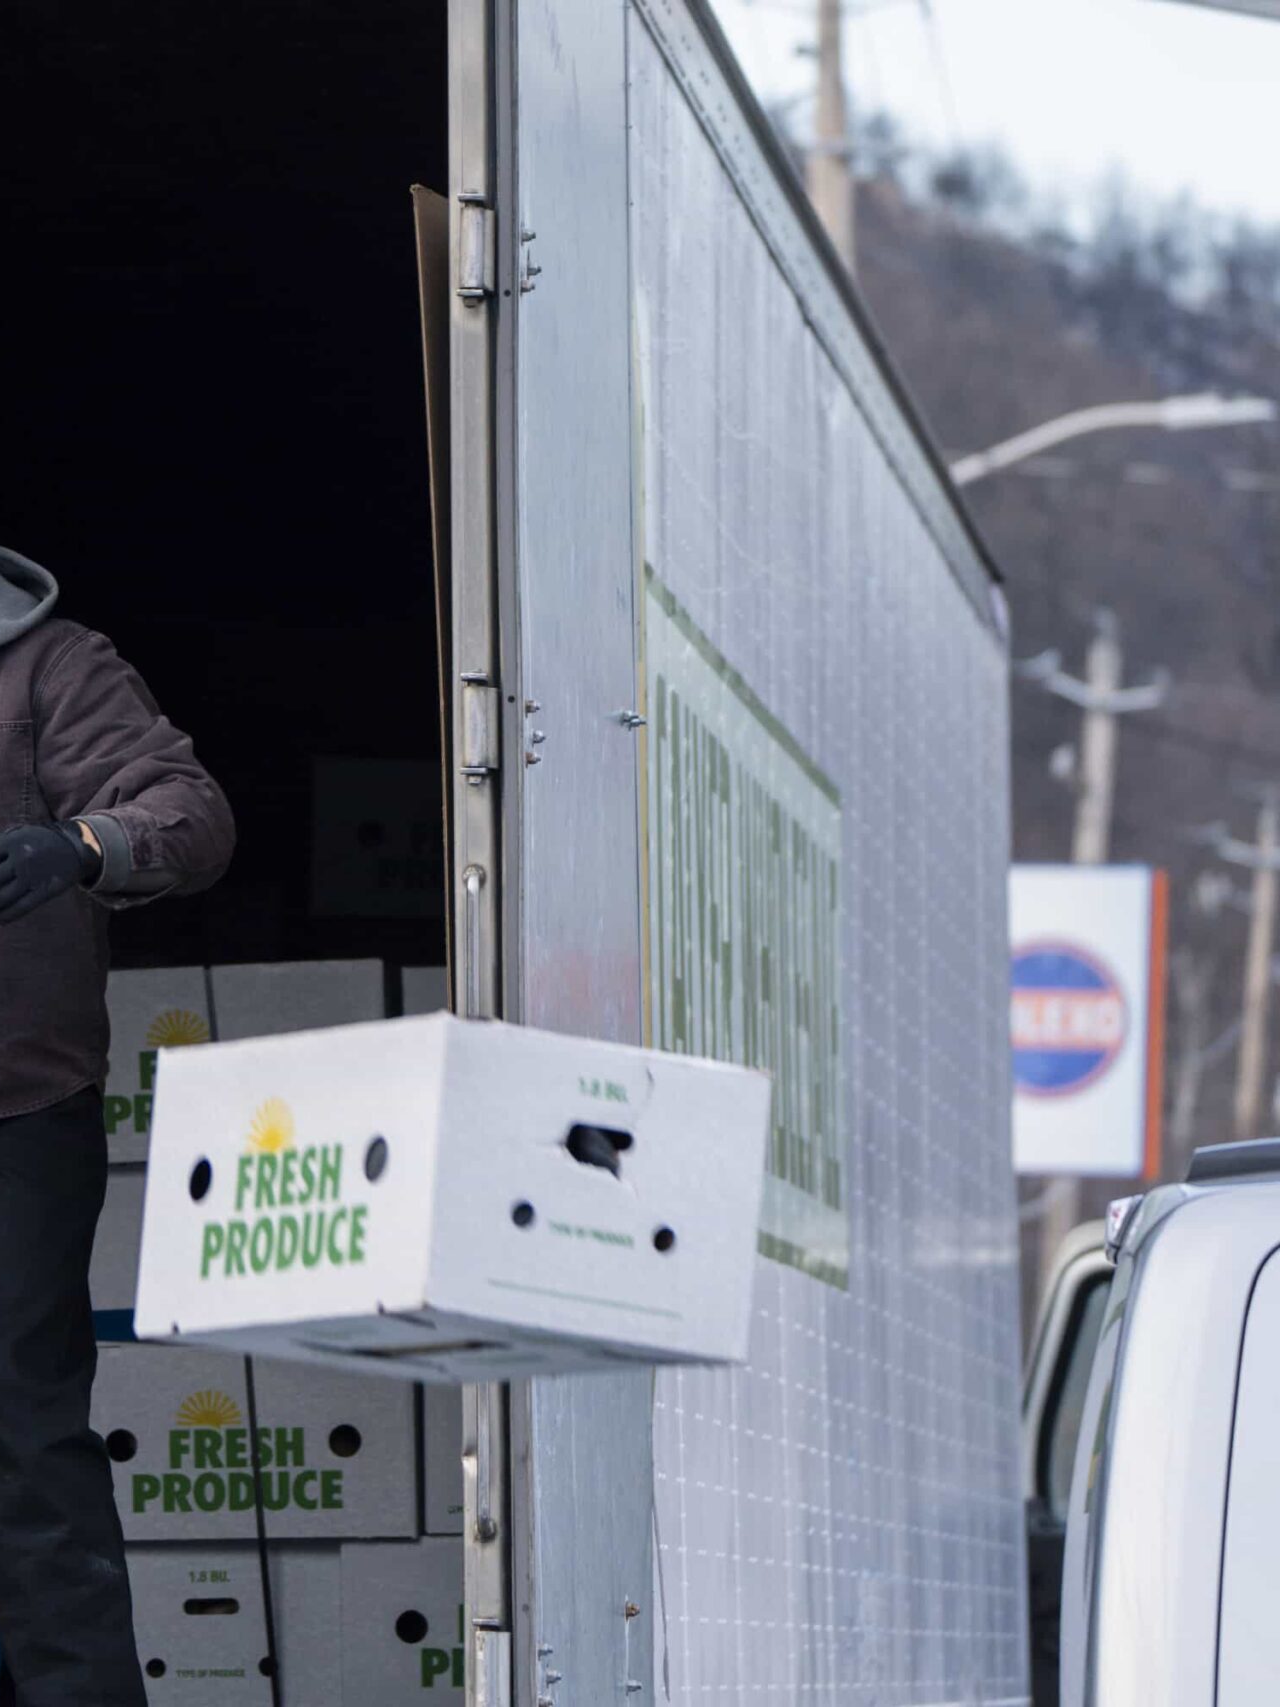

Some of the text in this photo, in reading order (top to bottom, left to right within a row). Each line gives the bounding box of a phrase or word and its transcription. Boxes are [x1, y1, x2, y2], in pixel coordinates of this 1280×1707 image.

[234, 1142, 343, 1211] FRESH
[200, 1205, 368, 1279] PRODUCE
[169, 1426, 304, 1469] FRESH
[132, 1469, 344, 1513] PRODUCE
[189, 1570, 231, 1584] 1.8 BU.
